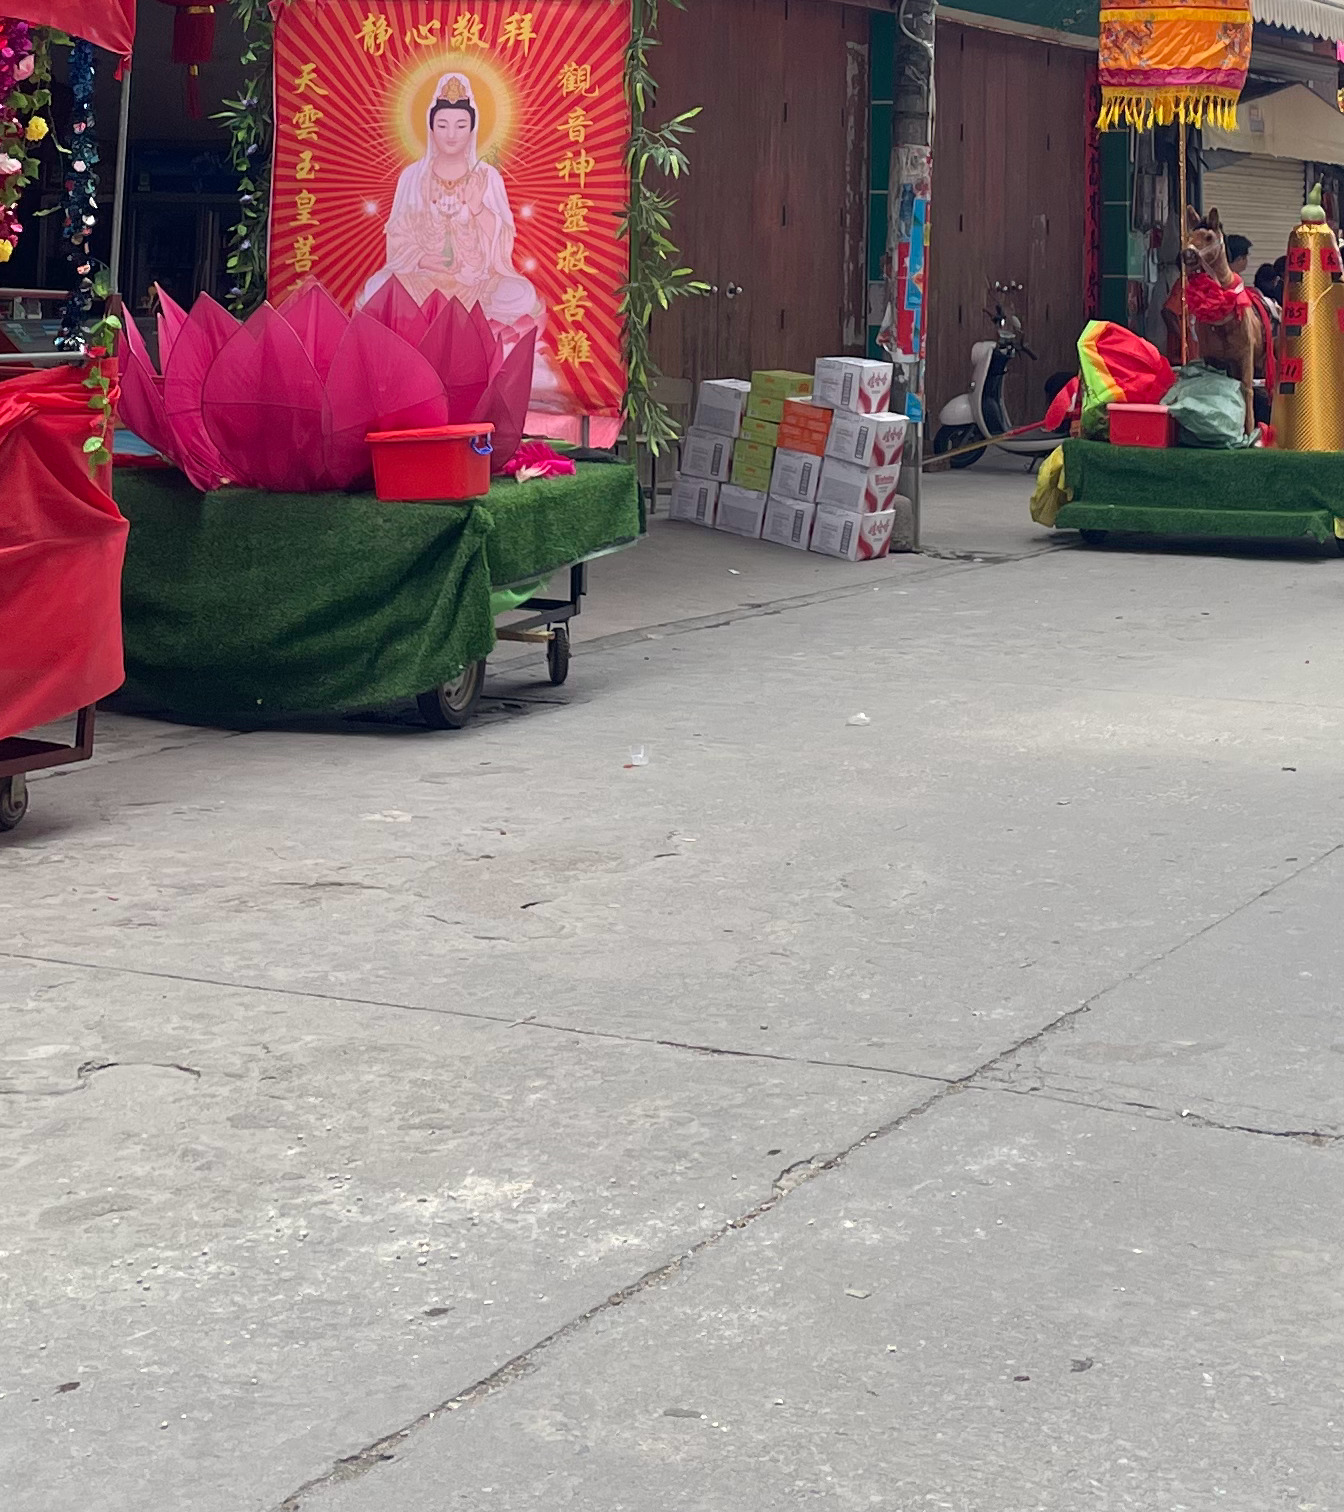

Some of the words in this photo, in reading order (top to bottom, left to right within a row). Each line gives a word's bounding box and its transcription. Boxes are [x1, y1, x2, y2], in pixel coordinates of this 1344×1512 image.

[355, 10, 537, 57] 静心敬拜
[285, 62, 330, 291] 天雲玉皇菩
